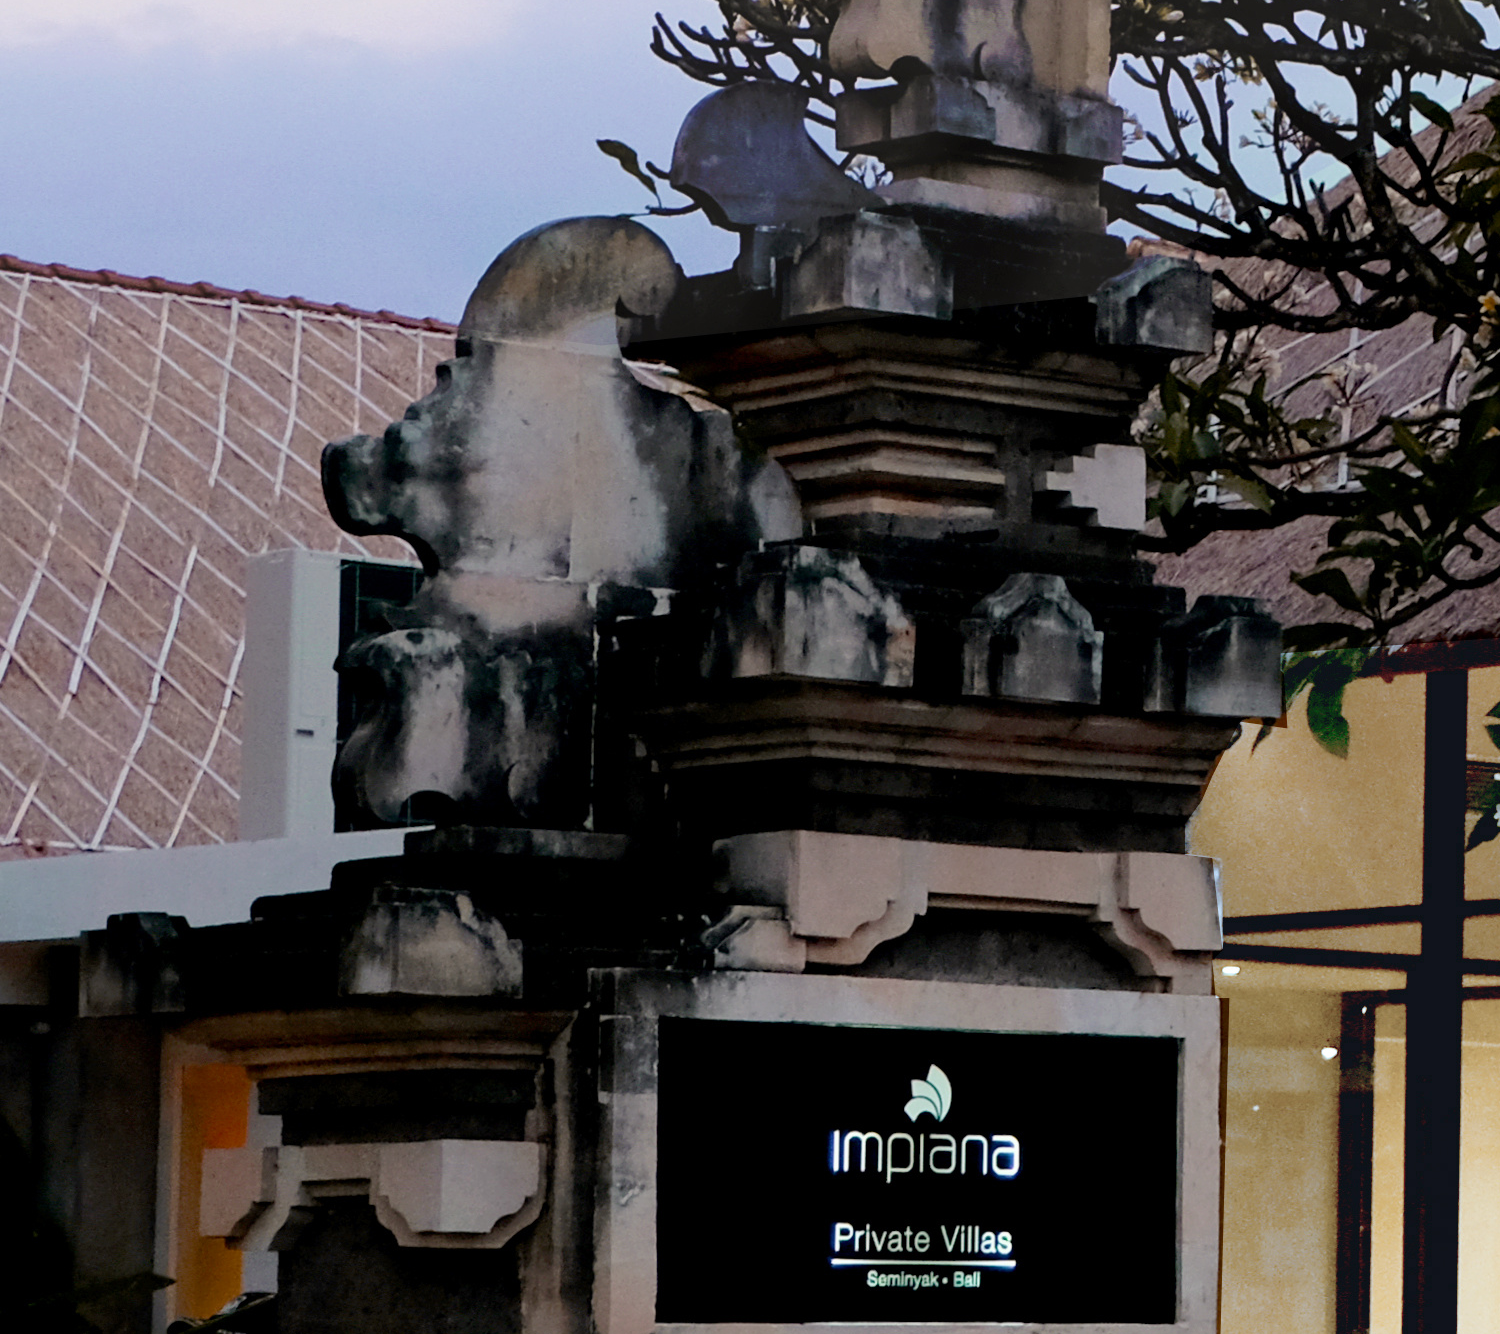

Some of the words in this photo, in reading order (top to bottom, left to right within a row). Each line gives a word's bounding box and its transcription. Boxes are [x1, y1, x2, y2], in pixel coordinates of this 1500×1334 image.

[834, 1222, 931, 1253] Private
[940, 1225, 1013, 1255] Villas
[867, 1270, 940, 1291] Seminyak
[953, 1271, 981, 1288] Bali
